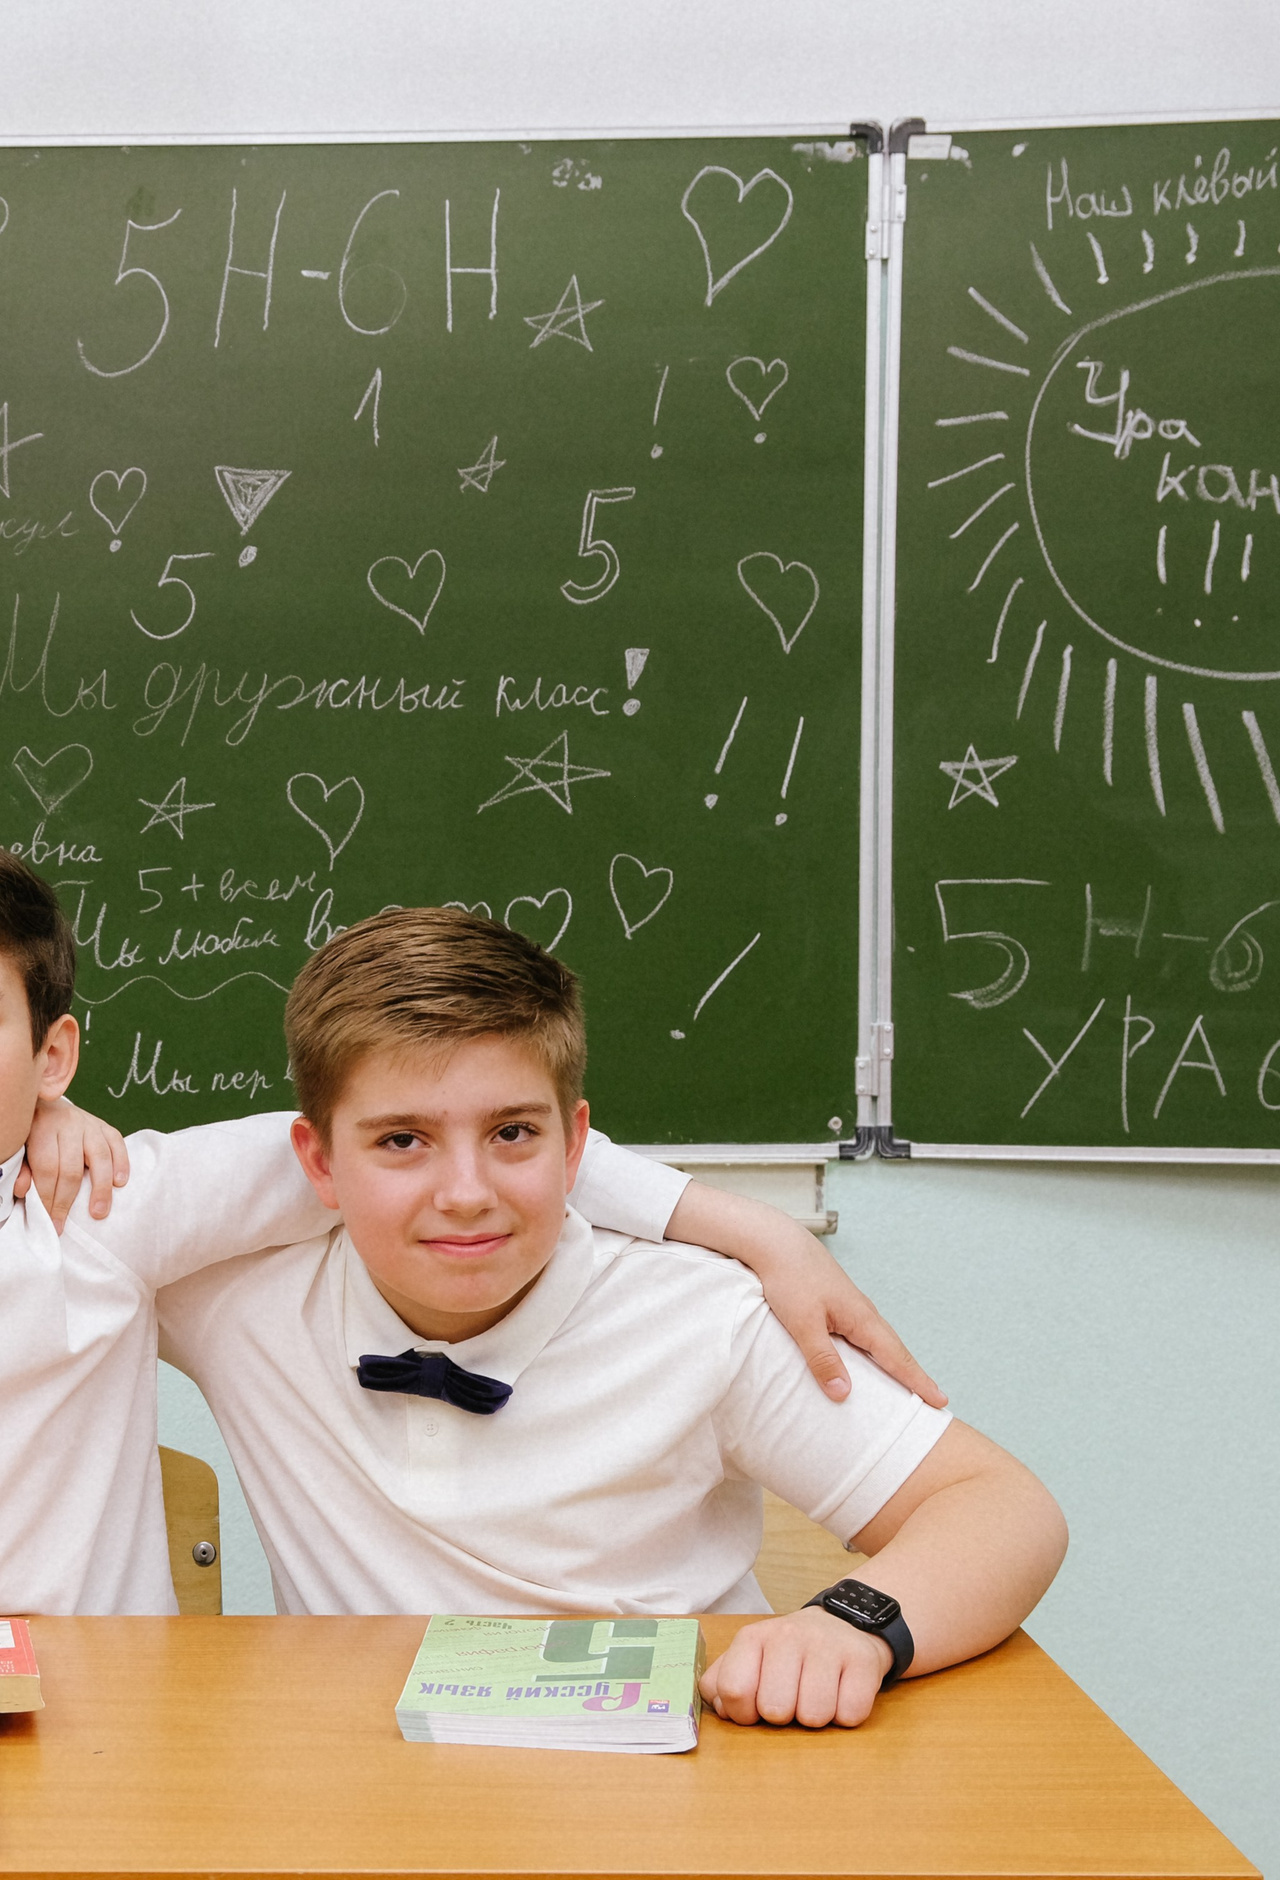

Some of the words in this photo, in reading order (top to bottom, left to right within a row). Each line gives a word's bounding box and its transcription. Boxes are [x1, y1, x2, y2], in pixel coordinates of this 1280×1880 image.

[1046, 157, 1133, 231] Наш
[1067, 355, 1201, 460] Ура
[132, 662, 467, 747] дружный
[106, 1031, 200, 1099] Мы
[532, 1618, 659, 1682] 5
[419, 1682, 492, 1698] язык
[506, 1681, 651, 1712] Русский
